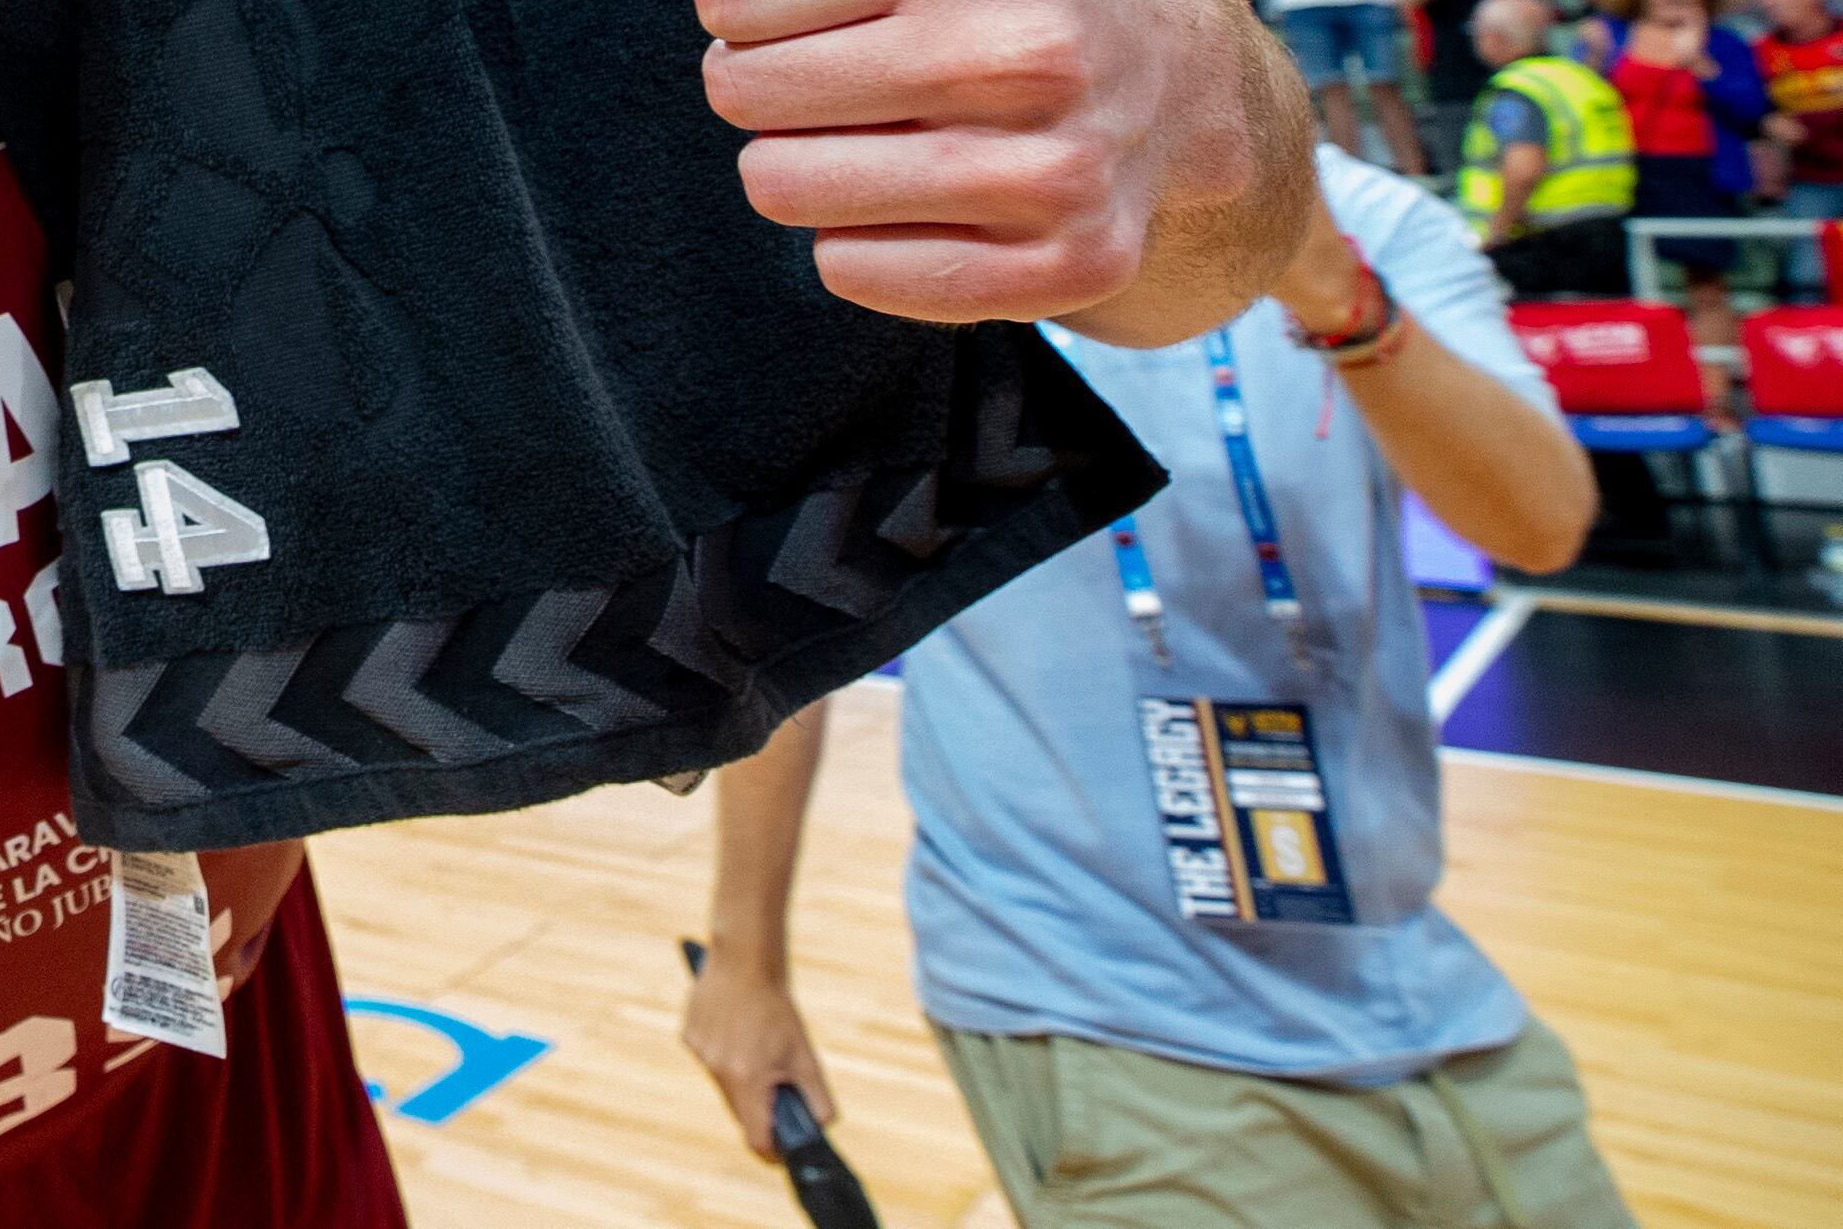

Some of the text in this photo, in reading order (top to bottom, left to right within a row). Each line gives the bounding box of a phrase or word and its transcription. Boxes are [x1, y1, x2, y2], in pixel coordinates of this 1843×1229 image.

[70, 366, 271, 594] 14
[11, 863, 62, 904] LA
[1168, 844, 1240, 922] THE
